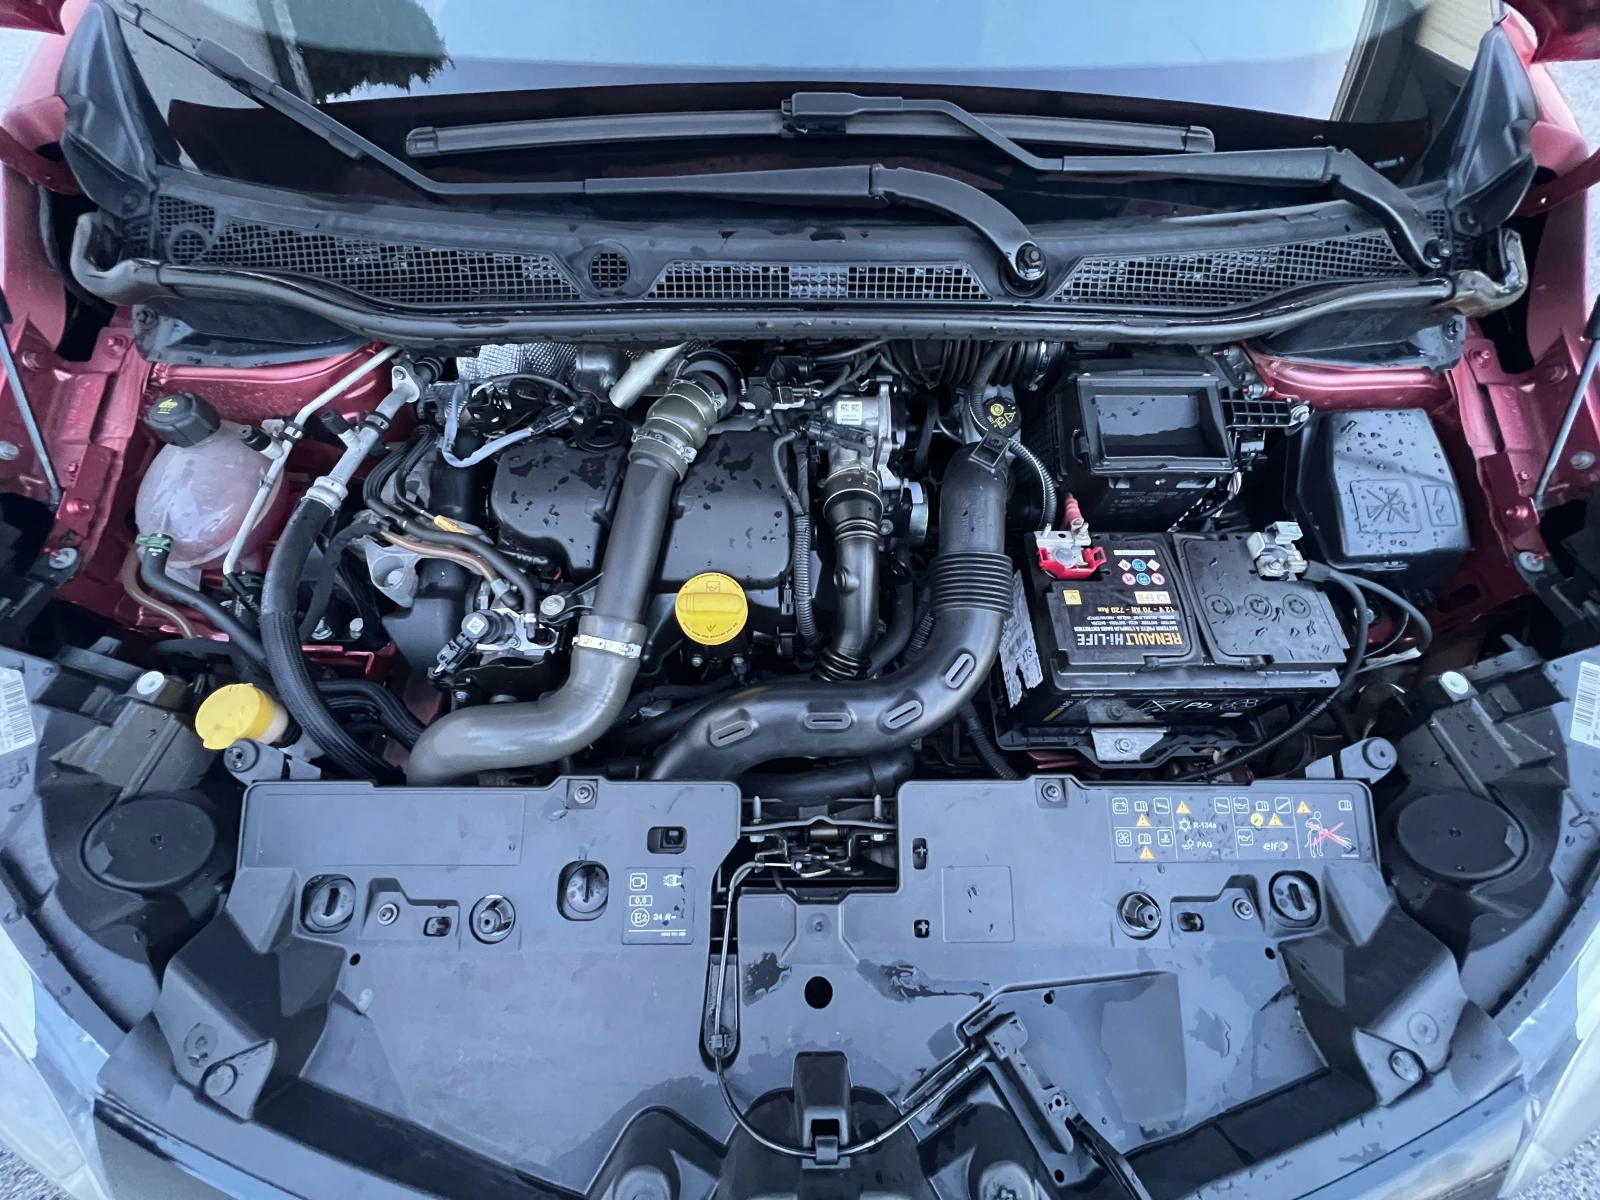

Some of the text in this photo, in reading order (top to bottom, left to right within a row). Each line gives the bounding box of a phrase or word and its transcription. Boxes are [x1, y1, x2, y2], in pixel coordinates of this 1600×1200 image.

[1126, 633, 1182, 645] RENAULT
[1183, 701, 1213, 709] Pb
[1196, 841, 1213, 849] PAG
[1263, 841, 1279, 851] elf
[653, 913, 663, 921] 24
